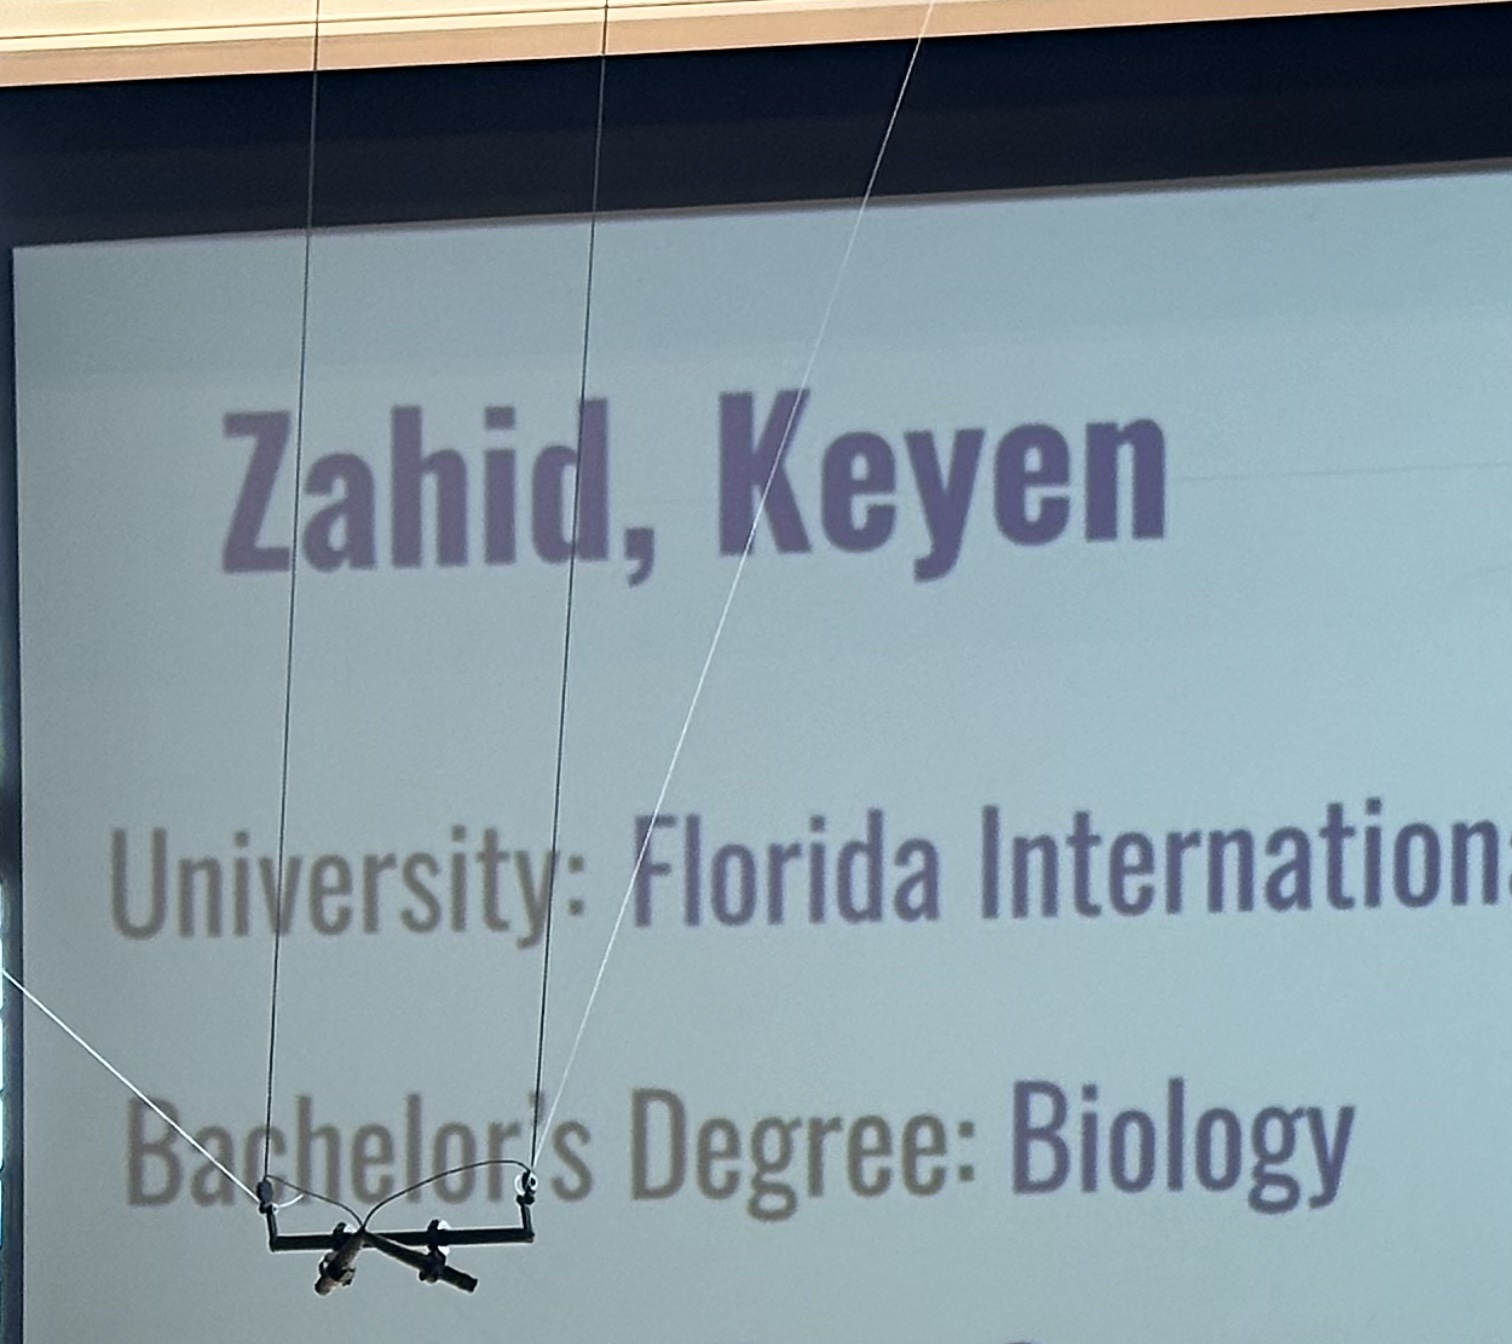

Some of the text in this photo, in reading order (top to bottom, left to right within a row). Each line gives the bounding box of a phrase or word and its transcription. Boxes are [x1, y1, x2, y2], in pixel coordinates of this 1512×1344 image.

[223, 389, 1166, 587] Zahid, Keyen
[111, 825, 586, 949] University:
[634, 808, 940, 928] Florida
[631, 1088, 975, 1222] Degree:
[1012, 1076, 1356, 1215] Biology
